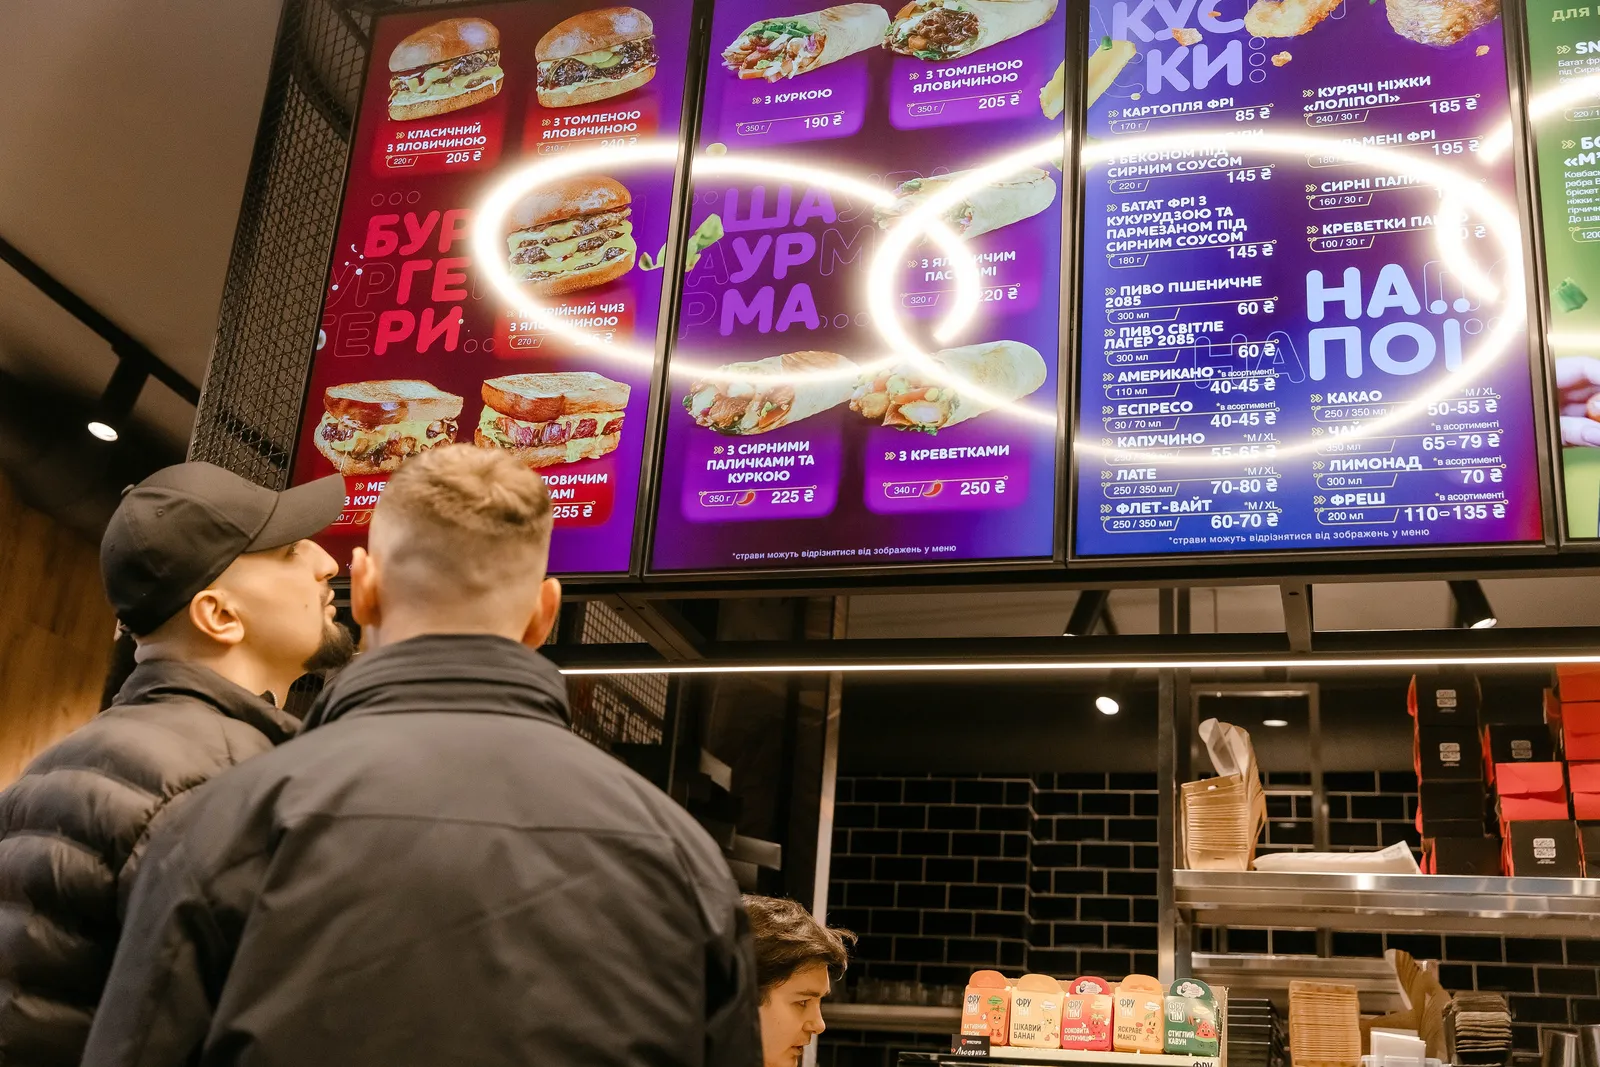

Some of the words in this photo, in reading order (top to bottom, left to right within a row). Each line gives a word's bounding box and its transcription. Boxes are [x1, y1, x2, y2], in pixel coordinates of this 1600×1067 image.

[937, 59, 1023, 78] ТОМЛЕНОЮ
[1146, 40, 1243, 95] КИ
[1558, 59, 1584, 67] Батат
[913, 72, 1018, 94] ЯЛОВИЧИНОЮ
[1318, 82, 1373, 98] КУРЯЧІ
[1378, 75, 1432, 92] НІЖКИ
[775, 88, 832, 104] КУРКОЮ
[1303, 93, 1401, 112] «ЛОЛІПОП»
[917, 105, 932, 114] 350
[978, 96, 1005, 110] 205
[1123, 101, 1203, 118] КАРТОПЛЯ
[1206, 97, 1234, 109] ФРІ
[1316, 114, 1333, 124] 240
[1341, 113, 1352, 121] 30
[1429, 100, 1461, 114] 185
[564, 110, 641, 126] ТОМЛЕНОЮ
[745, 124, 759, 132] 350
[804, 116, 829, 129] 190
[1120, 122, 1136, 130] 170
[1235, 108, 1255, 122] 85
[408, 122, 481, 140] КЛАСИЧНИЙ
[542, 122, 637, 140] ЯЛОВИЧИНОЮ
[1406, 129, 1436, 142] ФРІ
[396, 136, 486, 152] ЯЛОВИЧИНОЮ
[1432, 141, 1464, 156] 195
[446, 152, 470, 164] 205
[1120, 148, 1195, 166] БЕКОНОМ
[1199, 147, 1228, 159] ПІД
[1108, 163, 1172, 178] СИРНИМ
[1176, 156, 1242, 172] СОУСОМ
[1119, 182, 1135, 190] 220
[1226, 169, 1256, 184] 145
[1320, 178, 1370, 193] СИРНІ
[1566, 179, 1592, 188] ребра
[1320, 198, 1336, 206] 160
[1344, 196, 1356, 204] 30
[1566, 188, 1599, 197] бріскет
[723, 183, 837, 233] ША
[1122, 200, 1164, 213] БАТАТ
[1168, 196, 1195, 208] ФРІ
[1107, 208, 1212, 226] КУКУРУДЗОЮ
[1216, 206, 1234, 218] ТА
[1568, 216, 1582, 224] До
[363, 208, 473, 258] БУР
[1106, 221, 1212, 240] ПАРМЕЗАНОМ
[1216, 218, 1248, 232] ПІД
[1322, 217, 1406, 236] КРЕВЕТКИ
[1106, 238, 1172, 252] СИРНИМ
[1176, 232, 1244, 246] СОУСОМ
[1320, 240, 1338, 249] 100
[1346, 238, 1358, 247] 30
[729, 231, 817, 284] УР
[932, 250, 1016, 268] ЯЛИЧИМ
[1118, 256, 1134, 265] 180
[1227, 245, 1258, 259] 145
[396, 256, 472, 305] ГЕ
[925, 266, 997, 282] ПАСМІ
[1120, 283, 1164, 297] ПИВО
[1168, 276, 1262, 293] ПШЕНИЧНЕ
[1306, 263, 1421, 323] НА
[600, 302, 625, 314] ЧИЗ
[910, 296, 926, 304] 320
[1105, 296, 1142, 308] 2085
[719, 282, 821, 337] МА
[1117, 312, 1134, 320] 300
[1237, 302, 1258, 316] 60
[374, 305, 463, 356] РИ
[520, 316, 618, 332] ЯЛОЧИНОЮ
[1120, 324, 1164, 338] ПИВО
[1168, 320, 1224, 336] СВІТЛЕ
[517, 338, 532, 346] 270
[1104, 336, 1154, 350] ЛАГЕР
[1158, 333, 1195, 346] 2085
[1116, 354, 1134, 362] 300
[1238, 344, 1259, 358] 60
[1118, 366, 1214, 383] АМЕРИКАНО
[1227, 367, 1276, 378] асортименті
[1116, 388, 1132, 396] 110
[1210, 378, 1259, 394] 40-45
[1327, 390, 1382, 404] КАКАО
[1118, 400, 1194, 416] ЕСПРЕСО
[1226, 400, 1276, 412] асортименті
[1324, 410, 1342, 418] 250
[1352, 408, 1370, 417] 350
[1427, 400, 1480, 416] 50-55
[1114, 421, 1126, 430] 30
[1134, 420, 1146, 428] 70
[1210, 412, 1260, 428] 40-45
[1443, 420, 1499, 432] асортименті
[738, 440, 810, 455] СИРНИМИ
[1118, 432, 1206, 448] КАПУЧИНО
[911, 444, 1010, 461] КРЕВЕТКАМИ
[706, 456, 794, 471] ПАЛИЧКАМИ
[798, 454, 815, 466] ТА
[1329, 456, 1422, 472] ЛИМОНАД
[1445, 455, 1502, 466] асортименті
[541, 473, 608, 486] ЛОВИЧИМ
[728, 470, 790, 484] КУРКОЮ
[1116, 468, 1157, 481] ЛАТЕ
[1326, 477, 1345, 486] 300
[1460, 469, 1484, 484] 70
[894, 486, 910, 495] 340
[960, 481, 990, 496] 250
[1114, 486, 1132, 496] 250
[1139, 485, 1157, 494] 350
[1210, 478, 1261, 495] 70-80
[708, 494, 724, 504] 350
[771, 490, 800, 504] 225
[1116, 496, 1212, 515] ФЛЕТ-ВАЙТ
[1330, 492, 1386, 506] ФРЕШ
[1447, 490, 1504, 502] асортименті
[552, 506, 580, 518] 255
[1328, 512, 1346, 521] 200
[1112, 520, 1131, 530] 250
[1138, 519, 1156, 528] 350
[1210, 513, 1262, 530] 60-70
[1210, 536, 1246, 544] можуть
[1250, 532, 1312, 543] відрізнятися
[1316, 531, 1330, 540] від
[1333, 530, 1389, 540] зображень
[1402, 528, 1430, 537] меню
[767, 551, 799, 560] можуть
[802, 548, 856, 558] відрізнятися
[858, 548, 871, 556] від
[874, 546, 922, 556] зображень
[1016, 998, 1032, 1008] ФРУ
[1120, 998, 1136, 1008] ФРУ
[1014, 1022, 1042, 1032] ЦІКАВИЙ
[1118, 1026, 1142, 1034] ЯСКРАВЕ
[1168, 1030, 1195, 1038] СТИГЛИЙ
[1014, 1032, 1036, 1040] БАНАН
